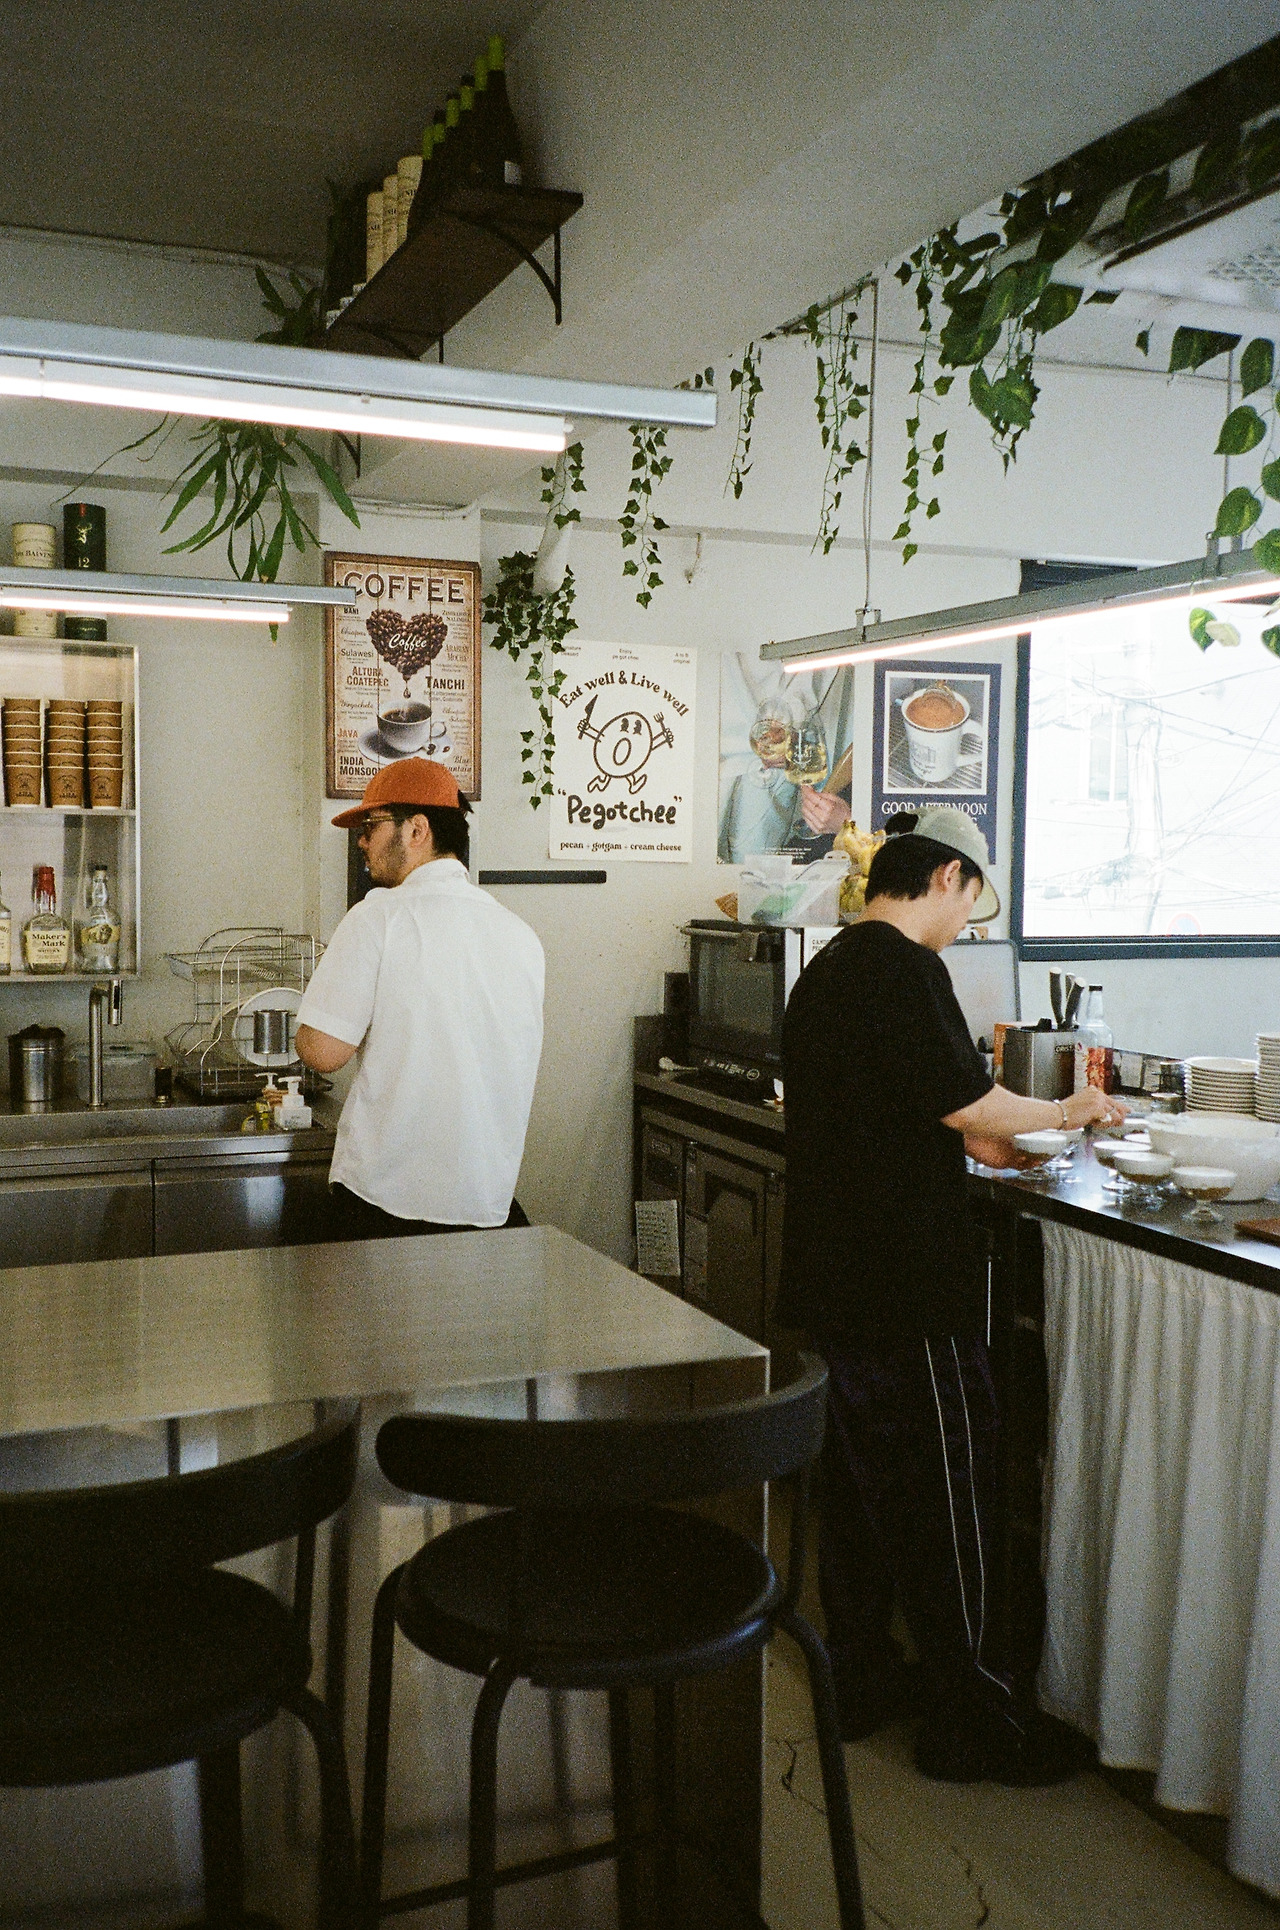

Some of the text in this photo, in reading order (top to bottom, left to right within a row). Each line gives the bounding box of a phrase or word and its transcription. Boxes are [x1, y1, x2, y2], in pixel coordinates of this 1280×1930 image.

[78, 557, 90, 568] 12
[344, 571, 464, 603] COFFEE
[388, 633, 427, 650] Coffee
[341, 648, 374, 658] Sulawesi
[352, 666, 383, 677] ALTURA
[346, 676, 389, 687] COATEPEC
[425, 676, 465, 690] TANCHI
[559, 670, 690, 717] Eat well & Live well
[337, 728, 358, 739] JAVA
[340, 756, 364, 766] INDIA
[881, 801, 916, 814] GOOD
[560, 842, 584, 851] pecan
[591, 842, 622, 852] gotgam
[656, 842, 682, 851] cheese
